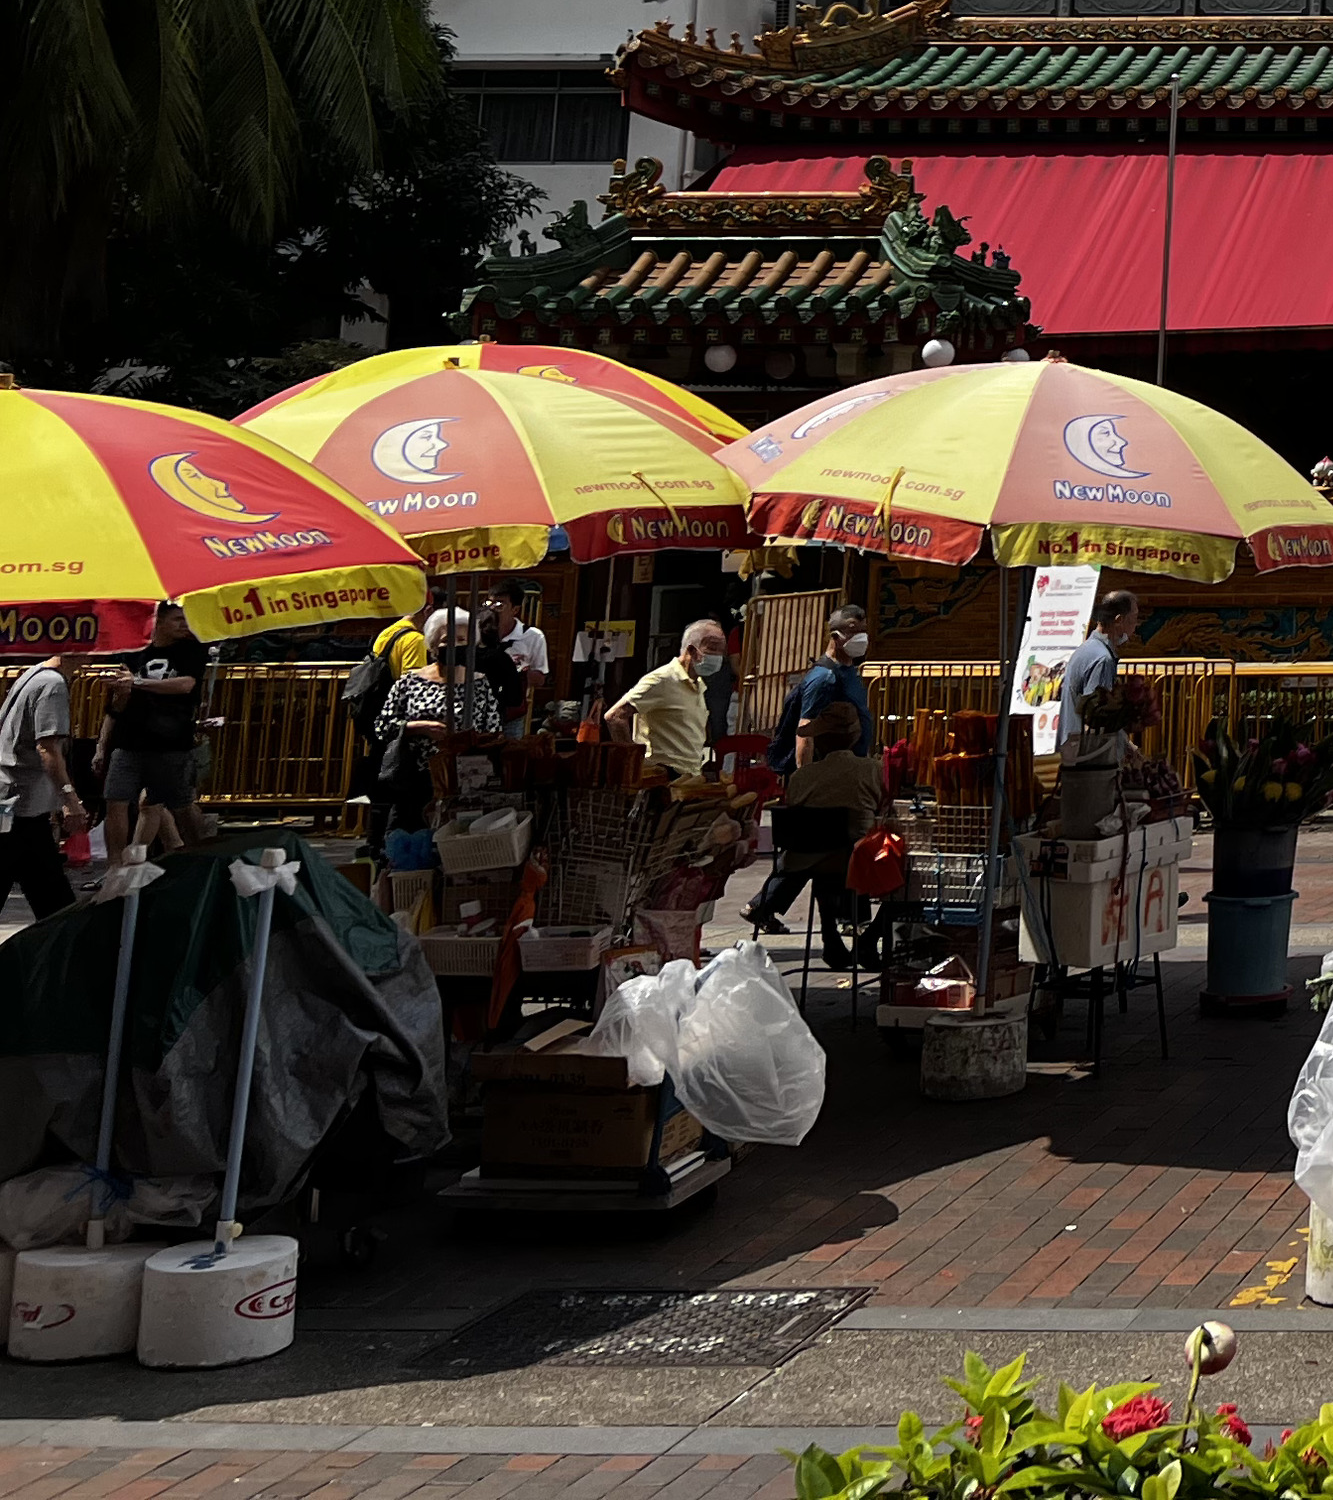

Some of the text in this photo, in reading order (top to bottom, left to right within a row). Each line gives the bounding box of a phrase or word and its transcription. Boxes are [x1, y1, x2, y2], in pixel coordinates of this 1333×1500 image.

[819, 467, 966, 501] newmoo.com.sg
[424, 544, 501, 568] gapore
[1105, 541, 1201, 565] Singapore
[269, 596, 288, 615] in
[291, 584, 391, 612] Singapore
